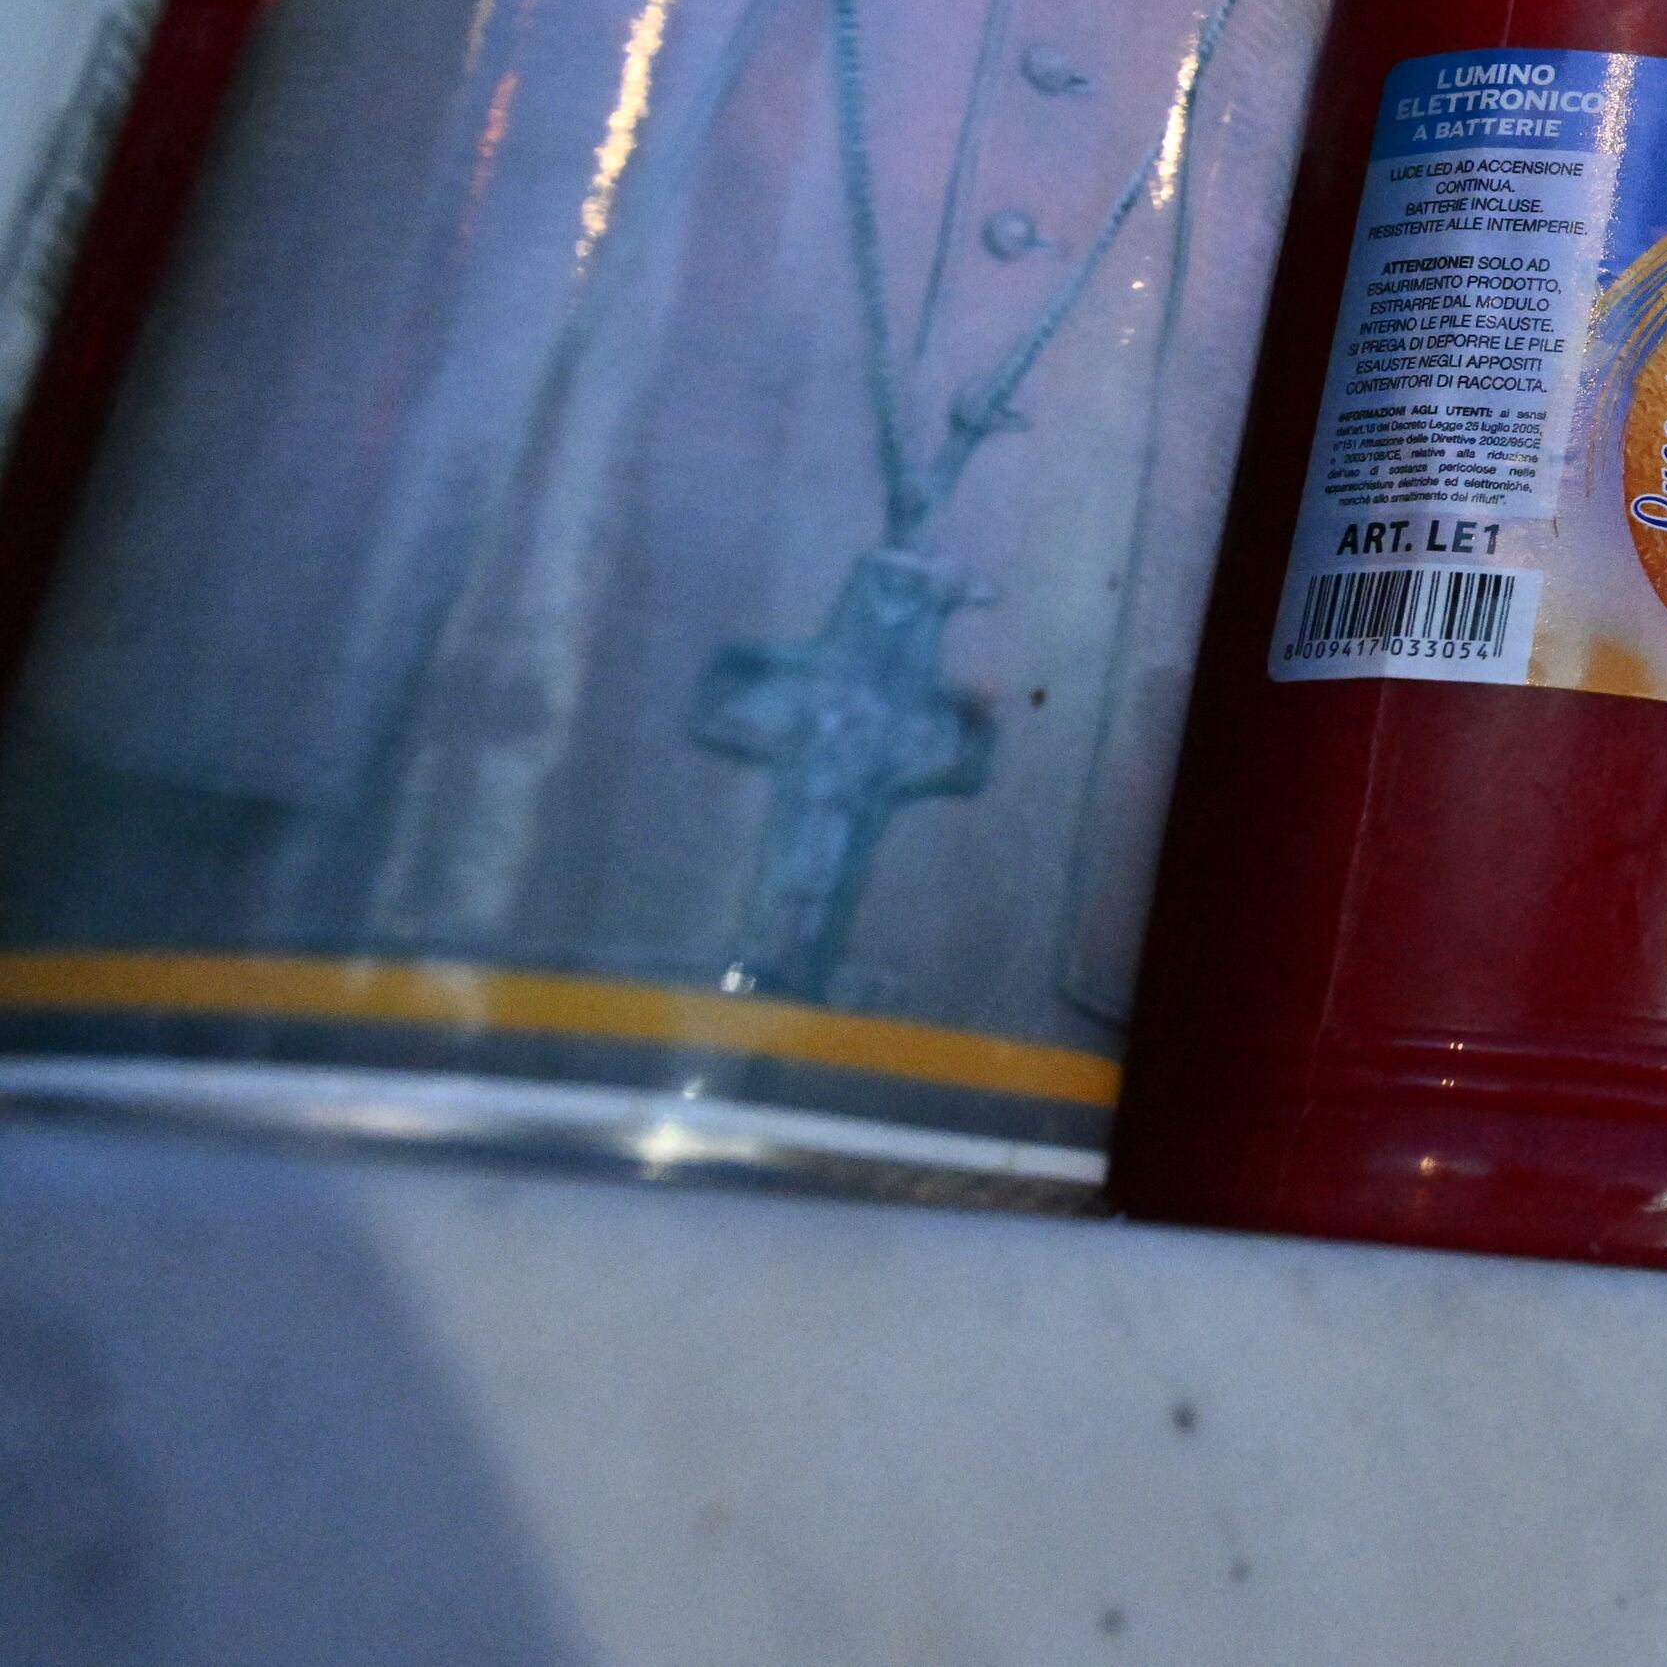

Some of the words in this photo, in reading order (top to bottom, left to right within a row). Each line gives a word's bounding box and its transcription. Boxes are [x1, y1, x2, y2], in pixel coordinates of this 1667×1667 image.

[1437, 63, 1556, 90] LUMINO
[1396, 88, 1604, 121] ELETTRONICO
[1412, 125, 1428, 142] A
[1434, 117, 1562, 139] BATTERIE
[1390, 163, 1424, 182] LUCE
[1426, 162, 1452, 178] LED
[1454, 159, 1475, 174] AD
[1477, 159, 1584, 177] ACCENSIONE
[1435, 178, 1516, 195] CONTINUA.
[1405, 198, 1469, 217] BATTERIE
[1470, 197, 1544, 214] INCLUSE.
[1367, 219, 1446, 242] RESISTENTE
[1446, 217, 1484, 232] ALLE
[1486, 217, 1589, 236] INTEMPERIE.
[1381, 255, 1475, 276] ATTENZIONE!
[1477, 256, 1524, 272] SOLO
[1526, 257, 1551, 273] AD
[1367, 274, 1464, 297] ESAURIMENTO
[1466, 275, 1562, 295] PRODOTTO,
[1370, 294, 1442, 315] ESTRARRE
[1442, 294, 1472, 309] DAL
[1475, 295, 1550, 312] MODULO
[1359, 316, 1418, 335] INTERNO
[1420, 315, 1438, 330] LE
[1439, 314, 1472, 329] PILE
[1475, 315, 1554, 333] ESAUSTE.
[1348, 341, 1361, 357] SI
[1361, 337, 1406, 354] PREGA
[1408, 336, 1424, 351] DI
[1426, 333, 1501, 350] DEPORRE
[1504, 335, 1525, 351] LE
[1527, 336, 1565, 353] PILE
[1355, 356, 1416, 374] ESAUSTE
[1416, 354, 1463, 370] NEGLI
[1465, 355, 1543, 372] APPOSITI
[1345, 375, 1434, 396] CONTENITORI
[1436, 374, 1453, 389] DI
[1456, 374, 1548, 394] RACCOLTA.
[1411, 404, 1439, 415] AGLI
[1446, 405, 1493, 418] UTENTI:
[1500, 408, 1510, 418] ai
[1517, 410, 1547, 421] sensi
[1391, 420, 1427, 431] Decreto
[1429, 418, 1464, 432] Legge
[1465, 420, 1480, 431] 25
[1480, 421, 1510, 435] luglio
[1512, 422, 1543, 437] 2005,
[1406, 433, 1429, 445] delle
[1431, 432, 1477, 445] Direttive
[1410, 447, 1446, 459] relative
[1486, 449, 1539, 463] riduzione
[1388, 463, 1428, 475] sostanze
[1438, 462, 1497, 475] pericolose
[1508, 466, 1537, 478] nelle
[1444, 476, 1459, 487] ed
[1463, 477, 1533, 493] elettroniche,
[1450, 491, 1469, 503] dei
[1336, 519, 1413, 555] ART.
[1426, 519, 1500, 555] LE1
[1302, 639, 1379, 660] 009417
[1390, 638, 1489, 661] 033054
